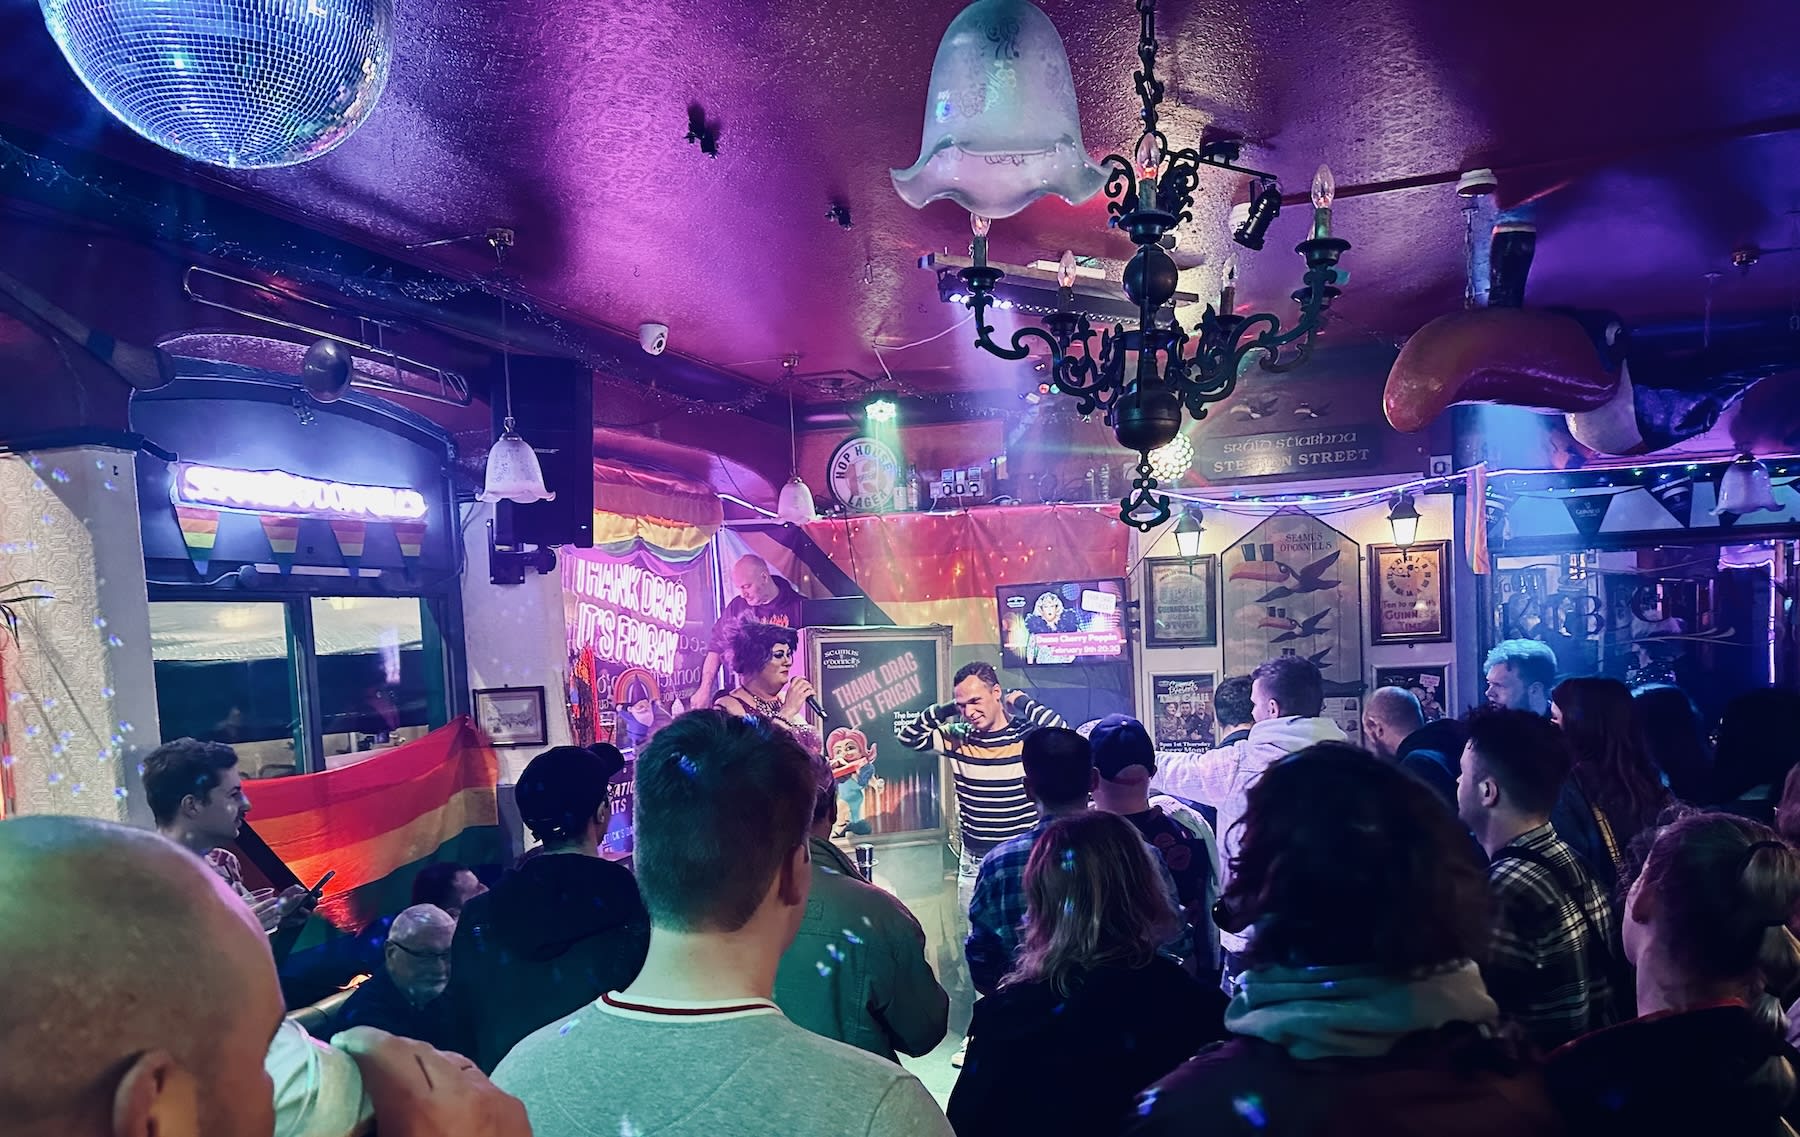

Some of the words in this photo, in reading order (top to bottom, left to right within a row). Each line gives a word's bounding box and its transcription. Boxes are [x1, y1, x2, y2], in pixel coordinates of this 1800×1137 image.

[835, 452, 850, 479] HOP
[854, 444, 893, 471] HOUSE
[1298, 448, 1370, 466] STREET
[848, 489, 888, 508] LAGER
[576, 560, 641, 612] THANK
[641, 568, 688, 629] DRAG
[831, 669, 882, 709] THANK
[879, 651, 918, 685] DRAG
[845, 699, 877, 728] IT'S
[874, 673, 922, 714] FRIGAY
[893, 711, 907, 719] The
